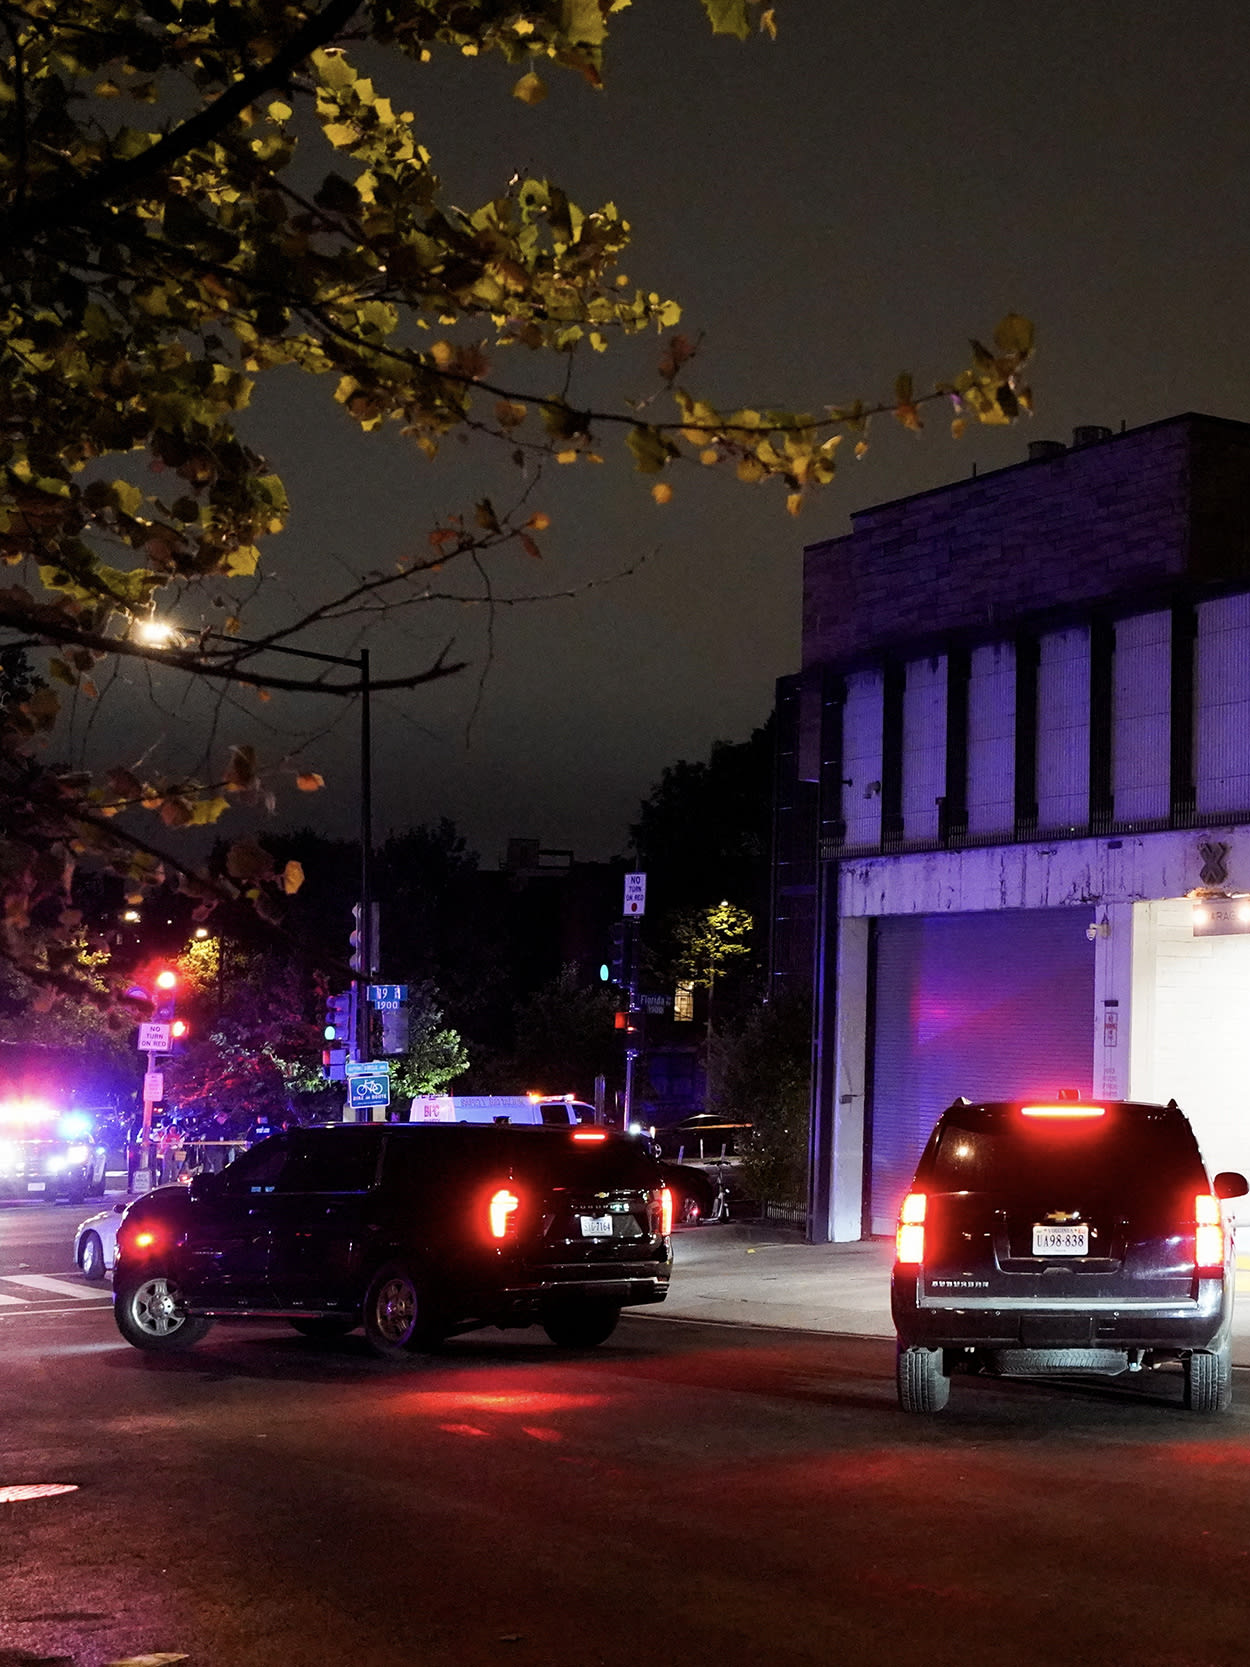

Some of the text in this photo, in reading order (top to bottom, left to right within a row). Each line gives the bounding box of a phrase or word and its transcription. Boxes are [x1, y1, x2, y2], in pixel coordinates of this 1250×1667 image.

[630, 876, 641, 885] NO
[640, 995, 665, 1005] Florida
[377, 1001, 398, 1009] 1900
[1037, 1234, 1084, 1247] UA98-838
